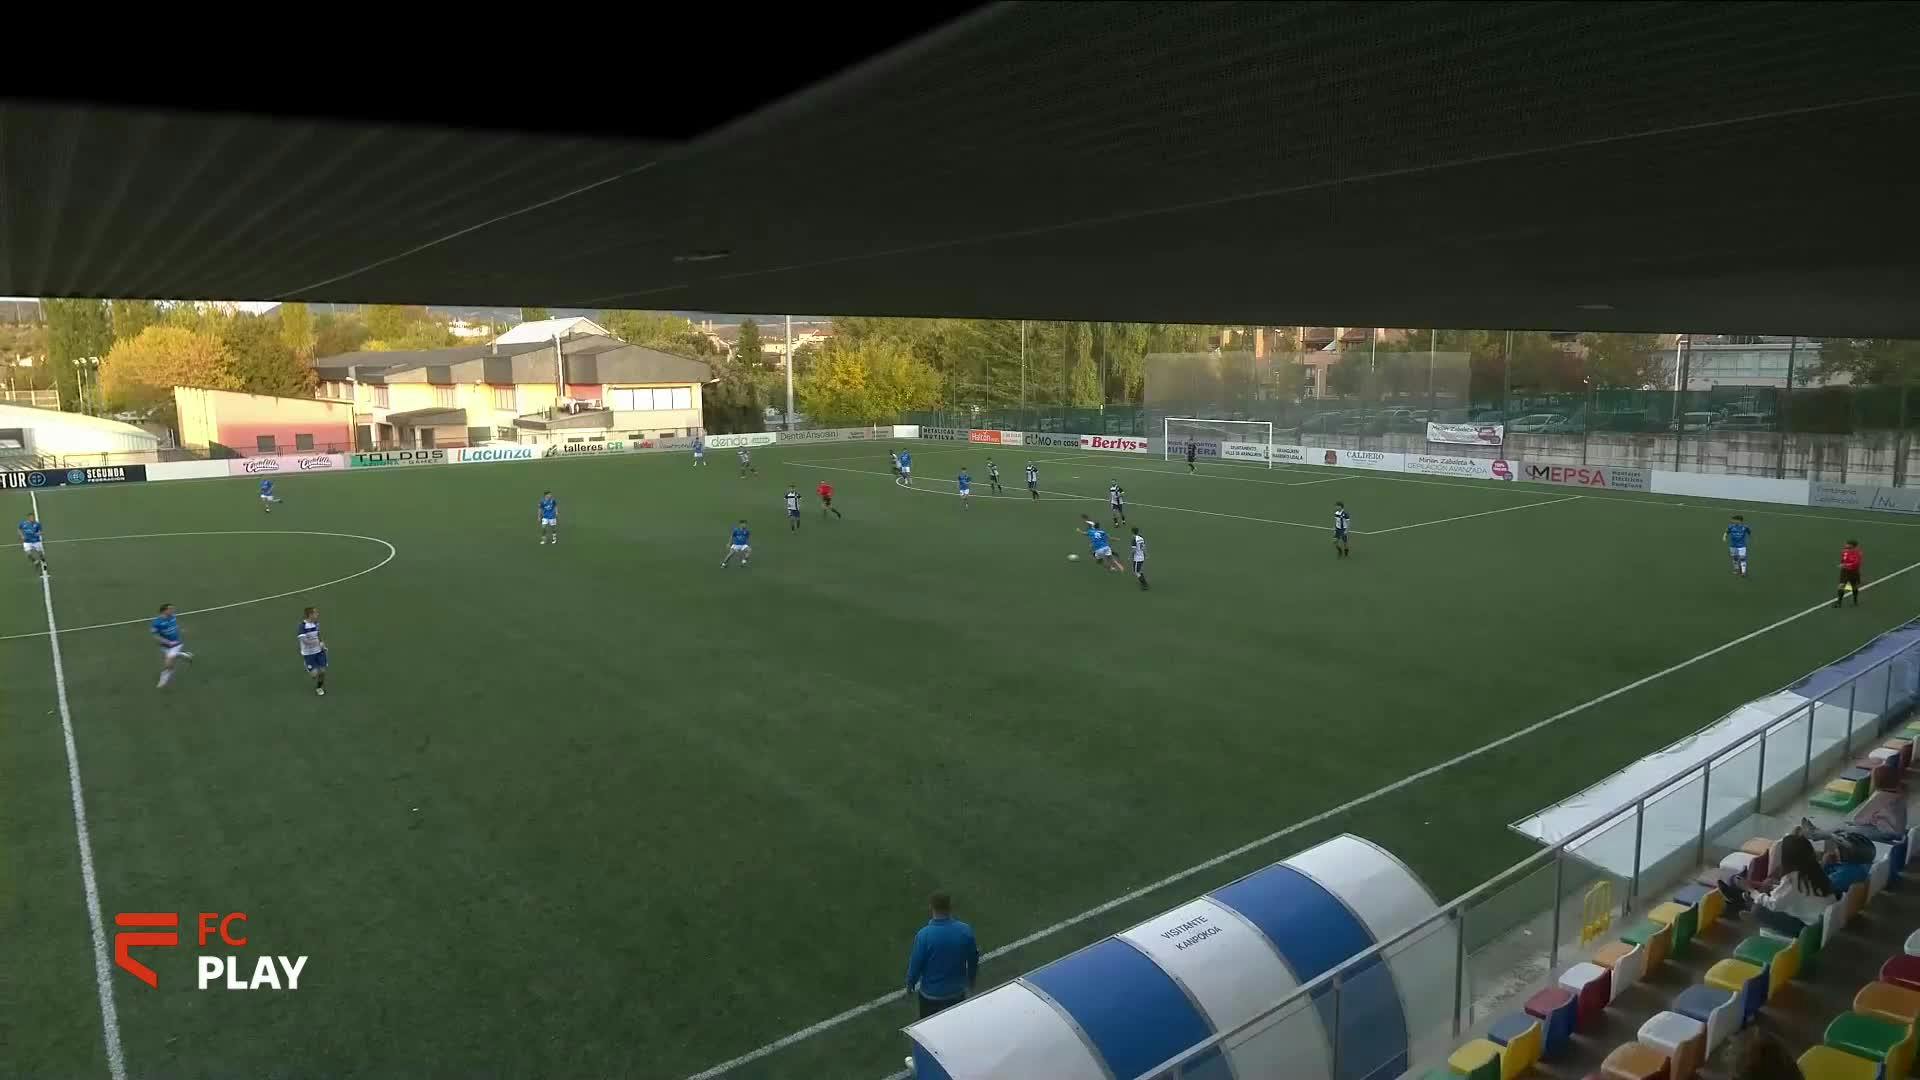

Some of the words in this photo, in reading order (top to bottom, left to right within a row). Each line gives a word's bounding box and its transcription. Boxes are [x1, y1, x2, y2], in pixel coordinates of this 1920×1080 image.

[564, 443, 603, 453] talleres
[1091, 437, 1136, 450] Berlys
[355, 450, 443, 463] TOLDOS
[462, 448, 532, 461] Lacunza
[1346, 451, 1384, 460] CALDERO
[86, 467, 125, 479] SEGUNDA
[1532, 465, 1606, 487] MEPSA
[0, 472, 27, 489] TUR
[1161, 915, 1209, 940] VISITANTE
[1175, 925, 1223, 951] KANPOKOA
